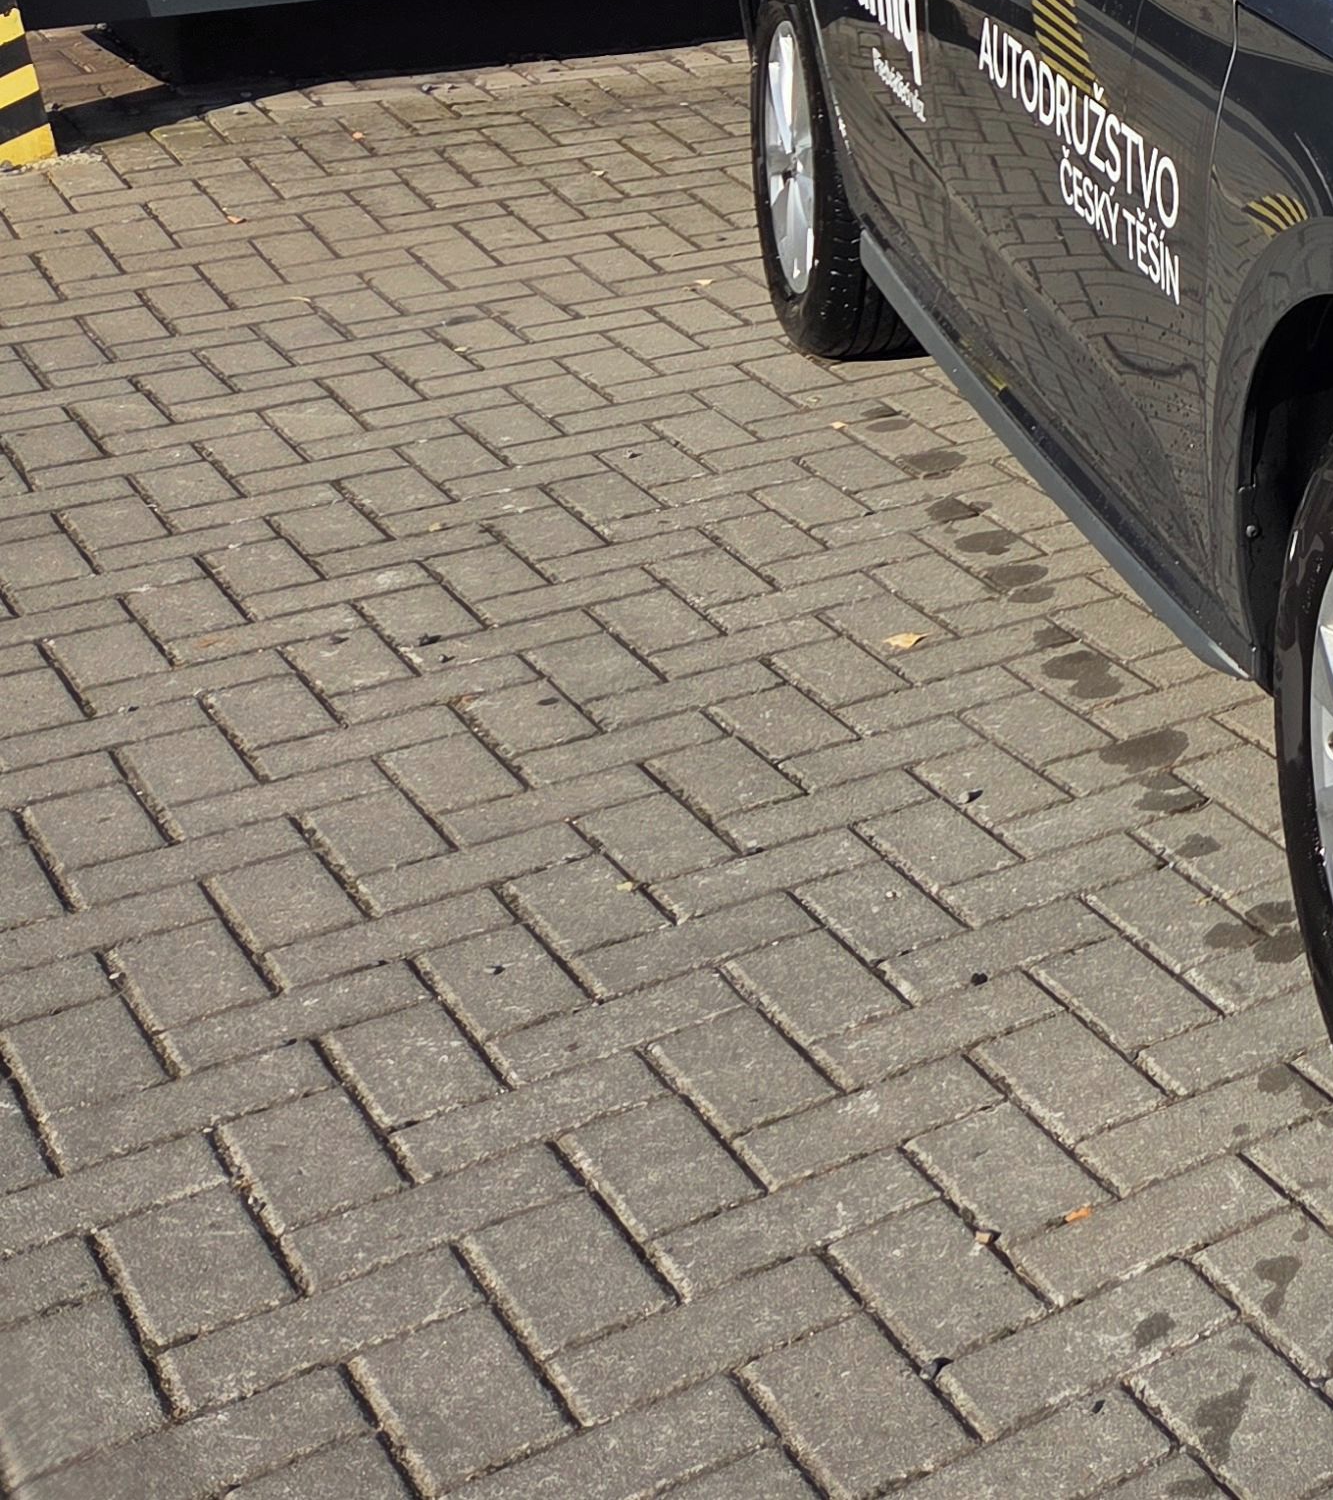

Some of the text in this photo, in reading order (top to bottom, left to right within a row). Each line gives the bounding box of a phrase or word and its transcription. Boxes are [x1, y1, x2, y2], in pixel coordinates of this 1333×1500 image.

[978, 17, 1180, 230] AUTODRUŽSTVO
[1059, 145, 1181, 306] ČESKÝ TĚŠÍN
